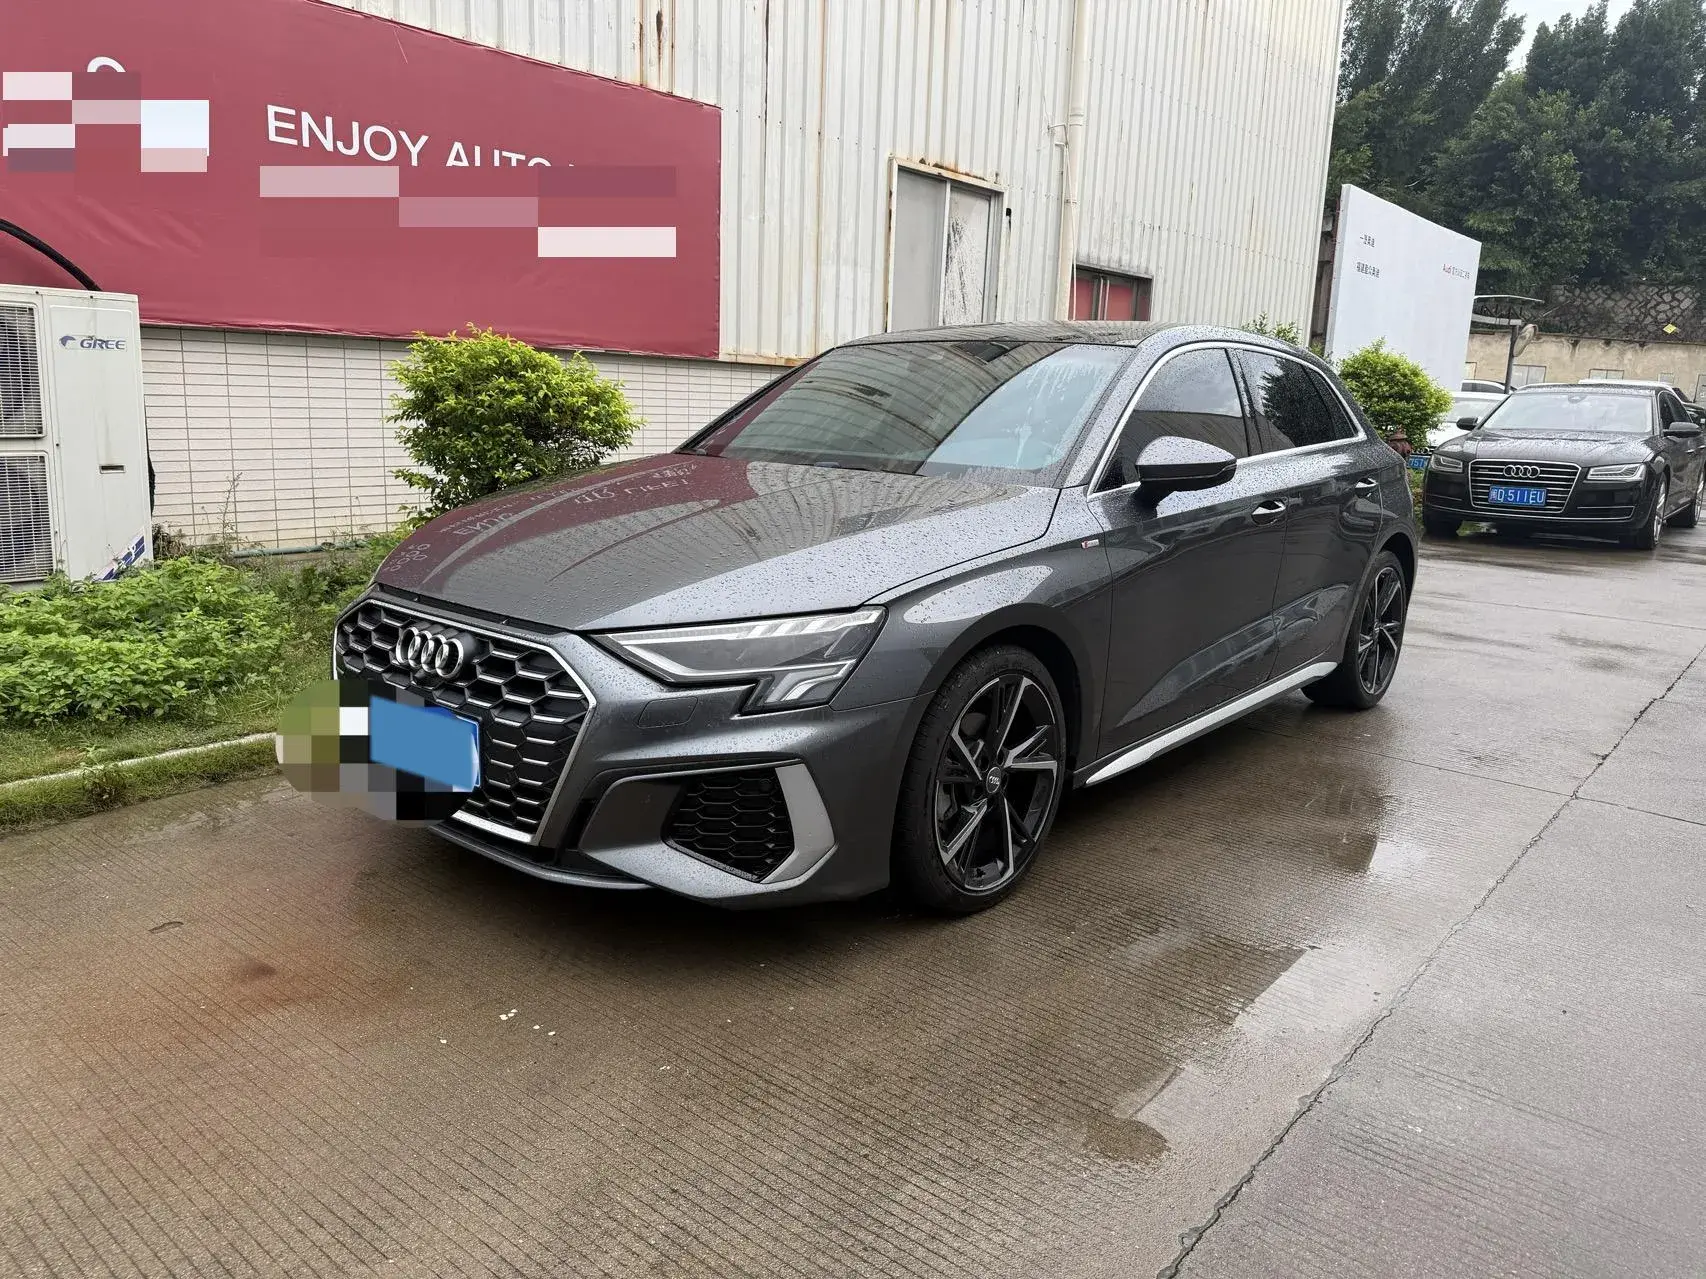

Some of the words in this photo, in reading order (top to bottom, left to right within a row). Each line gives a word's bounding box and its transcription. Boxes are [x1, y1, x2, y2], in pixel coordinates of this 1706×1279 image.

[267, 104, 429, 166] ENJOY
[446, 141, 552, 166] AU
[80, 338, 126, 350] GREE
